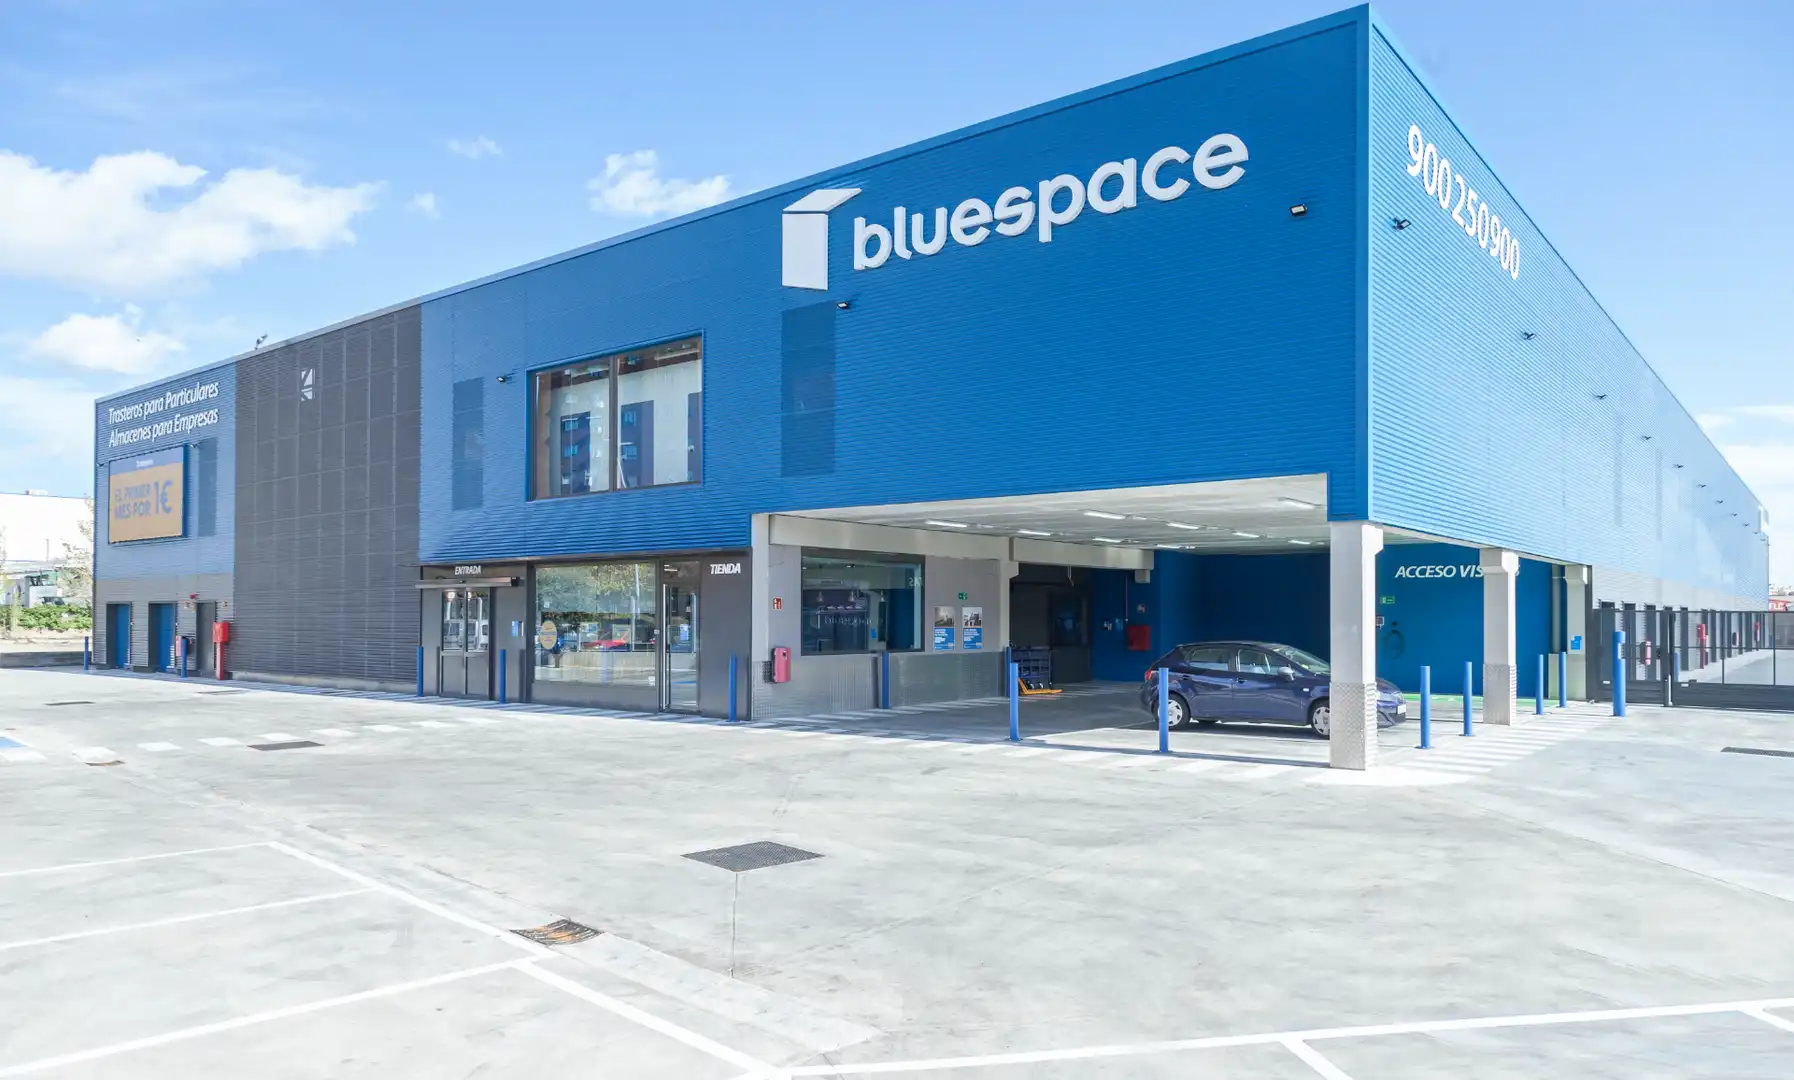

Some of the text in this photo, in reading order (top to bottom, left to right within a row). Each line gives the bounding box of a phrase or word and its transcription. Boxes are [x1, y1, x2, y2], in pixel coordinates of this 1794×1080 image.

[1407, 124, 1451, 209] 900
[853, 133, 1249, 270] bluespace
[109, 382, 219, 425] Trasteros para Particulares
[109, 409, 219, 448] Almacenes para Empresas
[153, 480, 173, 514] 1€
[455, 565, 481, 576] ENTRADA
[710, 562, 741, 575] TIENDA
[1395, 565, 1456, 578] ACCESO
